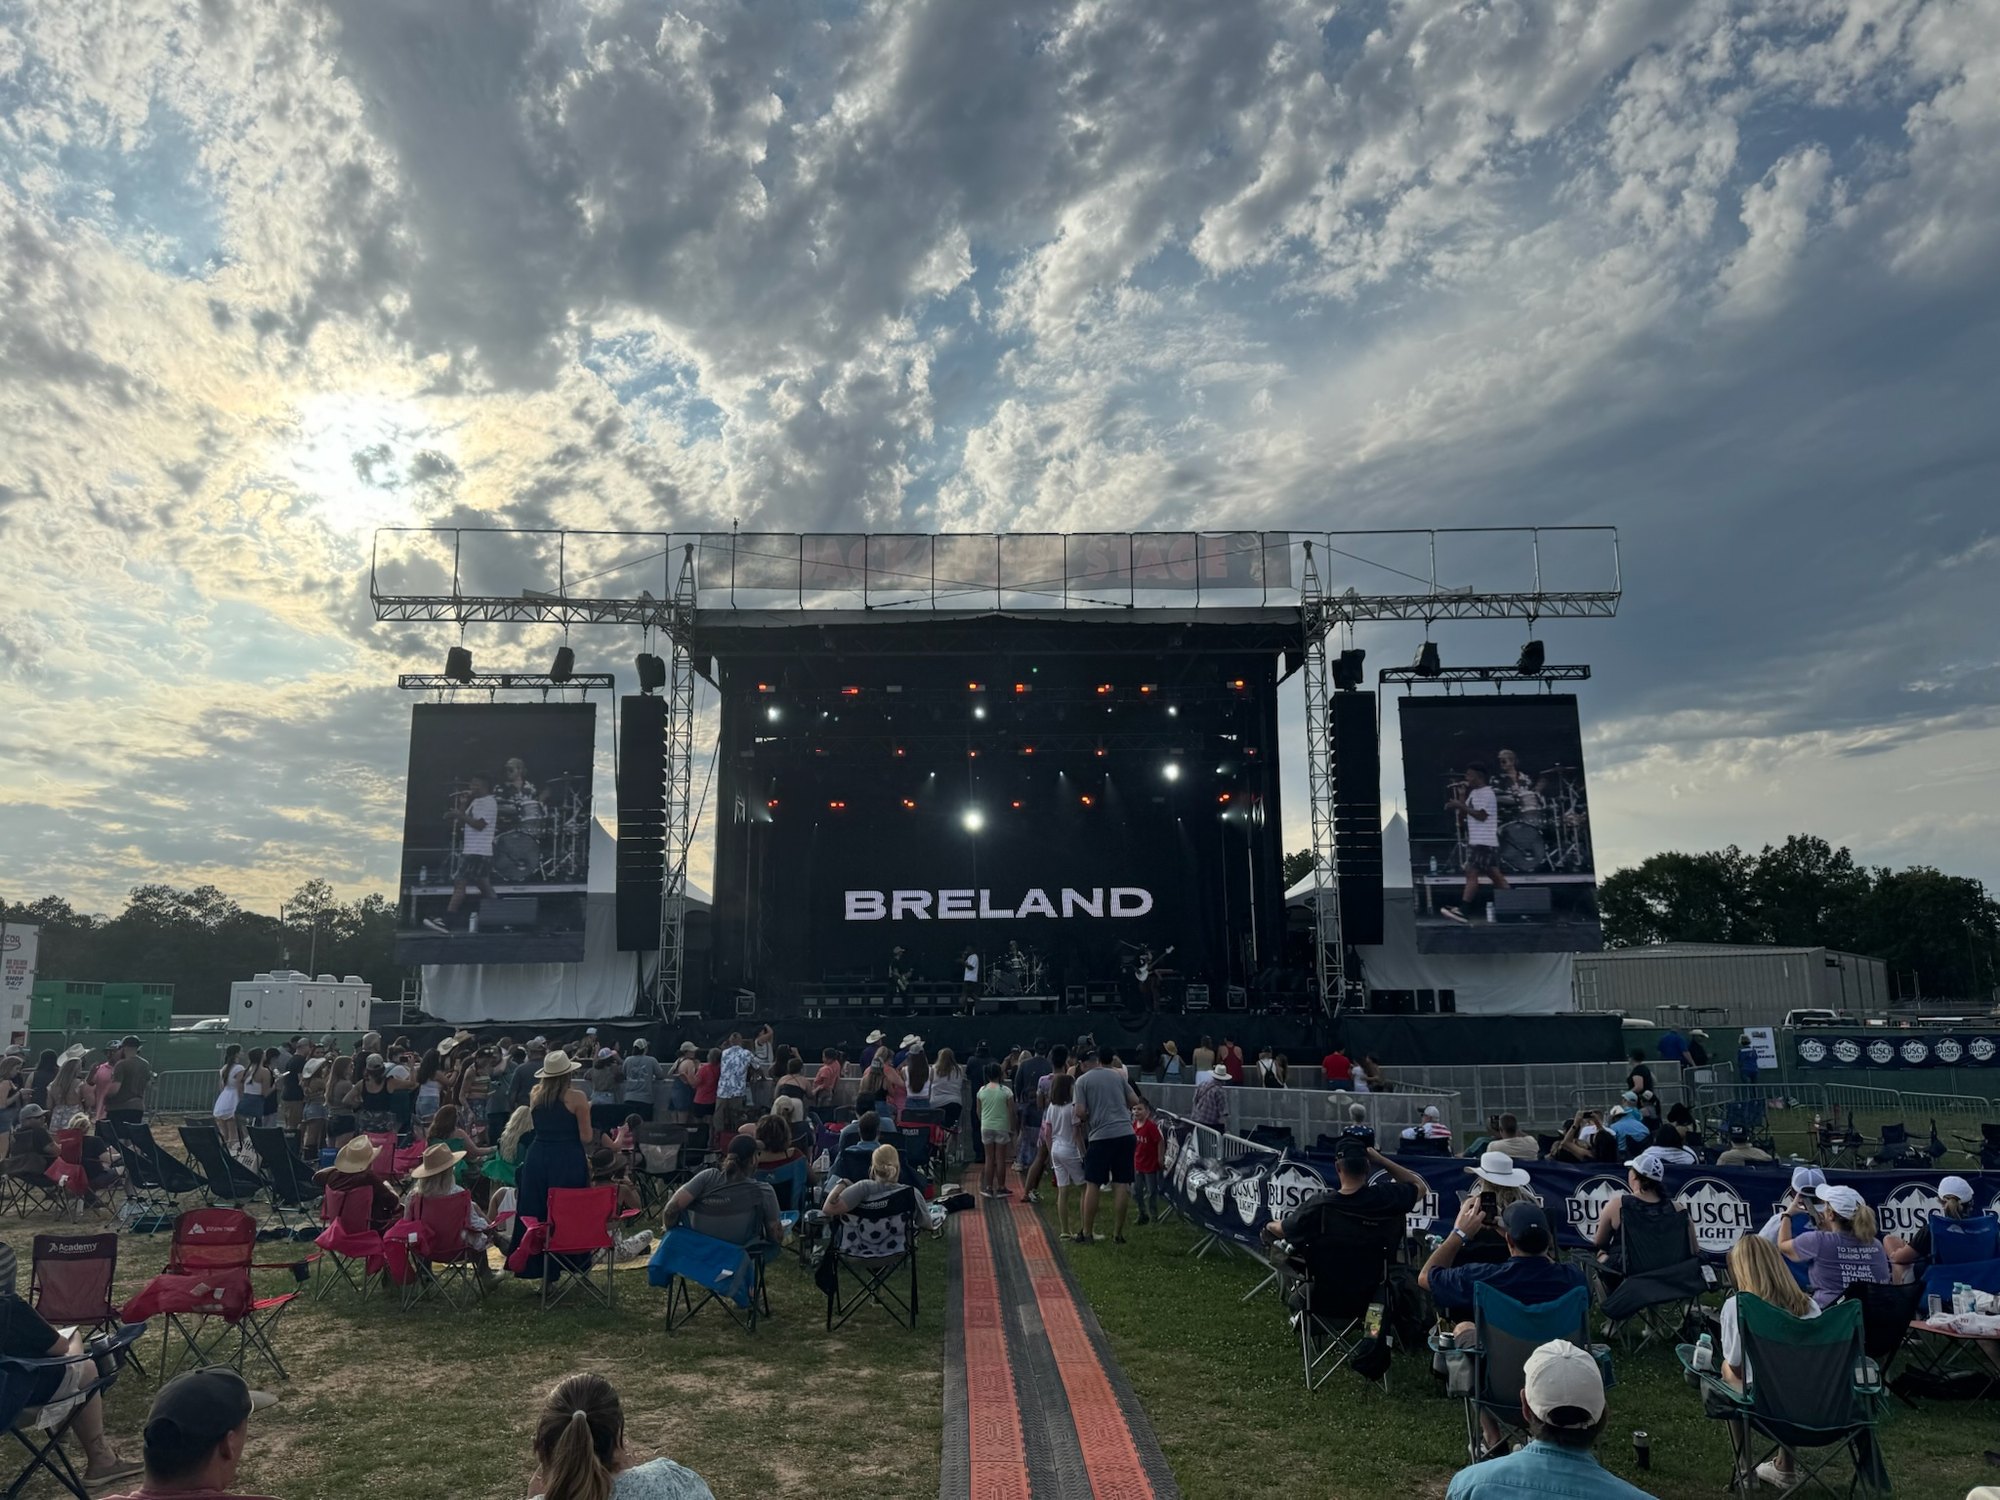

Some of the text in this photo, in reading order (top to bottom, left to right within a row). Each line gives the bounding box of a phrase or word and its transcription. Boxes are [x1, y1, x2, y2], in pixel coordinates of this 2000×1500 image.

[845, 888, 1153, 920] BRELAND
[1800, 1046, 1825, 1055] BUSCH
[1901, 1047, 1927, 1055] BUSCH
[1936, 1046, 1960, 1055] BUSCH
[1269, 1184, 1333, 1207] BUSC
[1688, 1203, 1751, 1227] USCH
[1880, 1208, 1941, 1229] BUS
[59, 1242, 97, 1252] Academy
